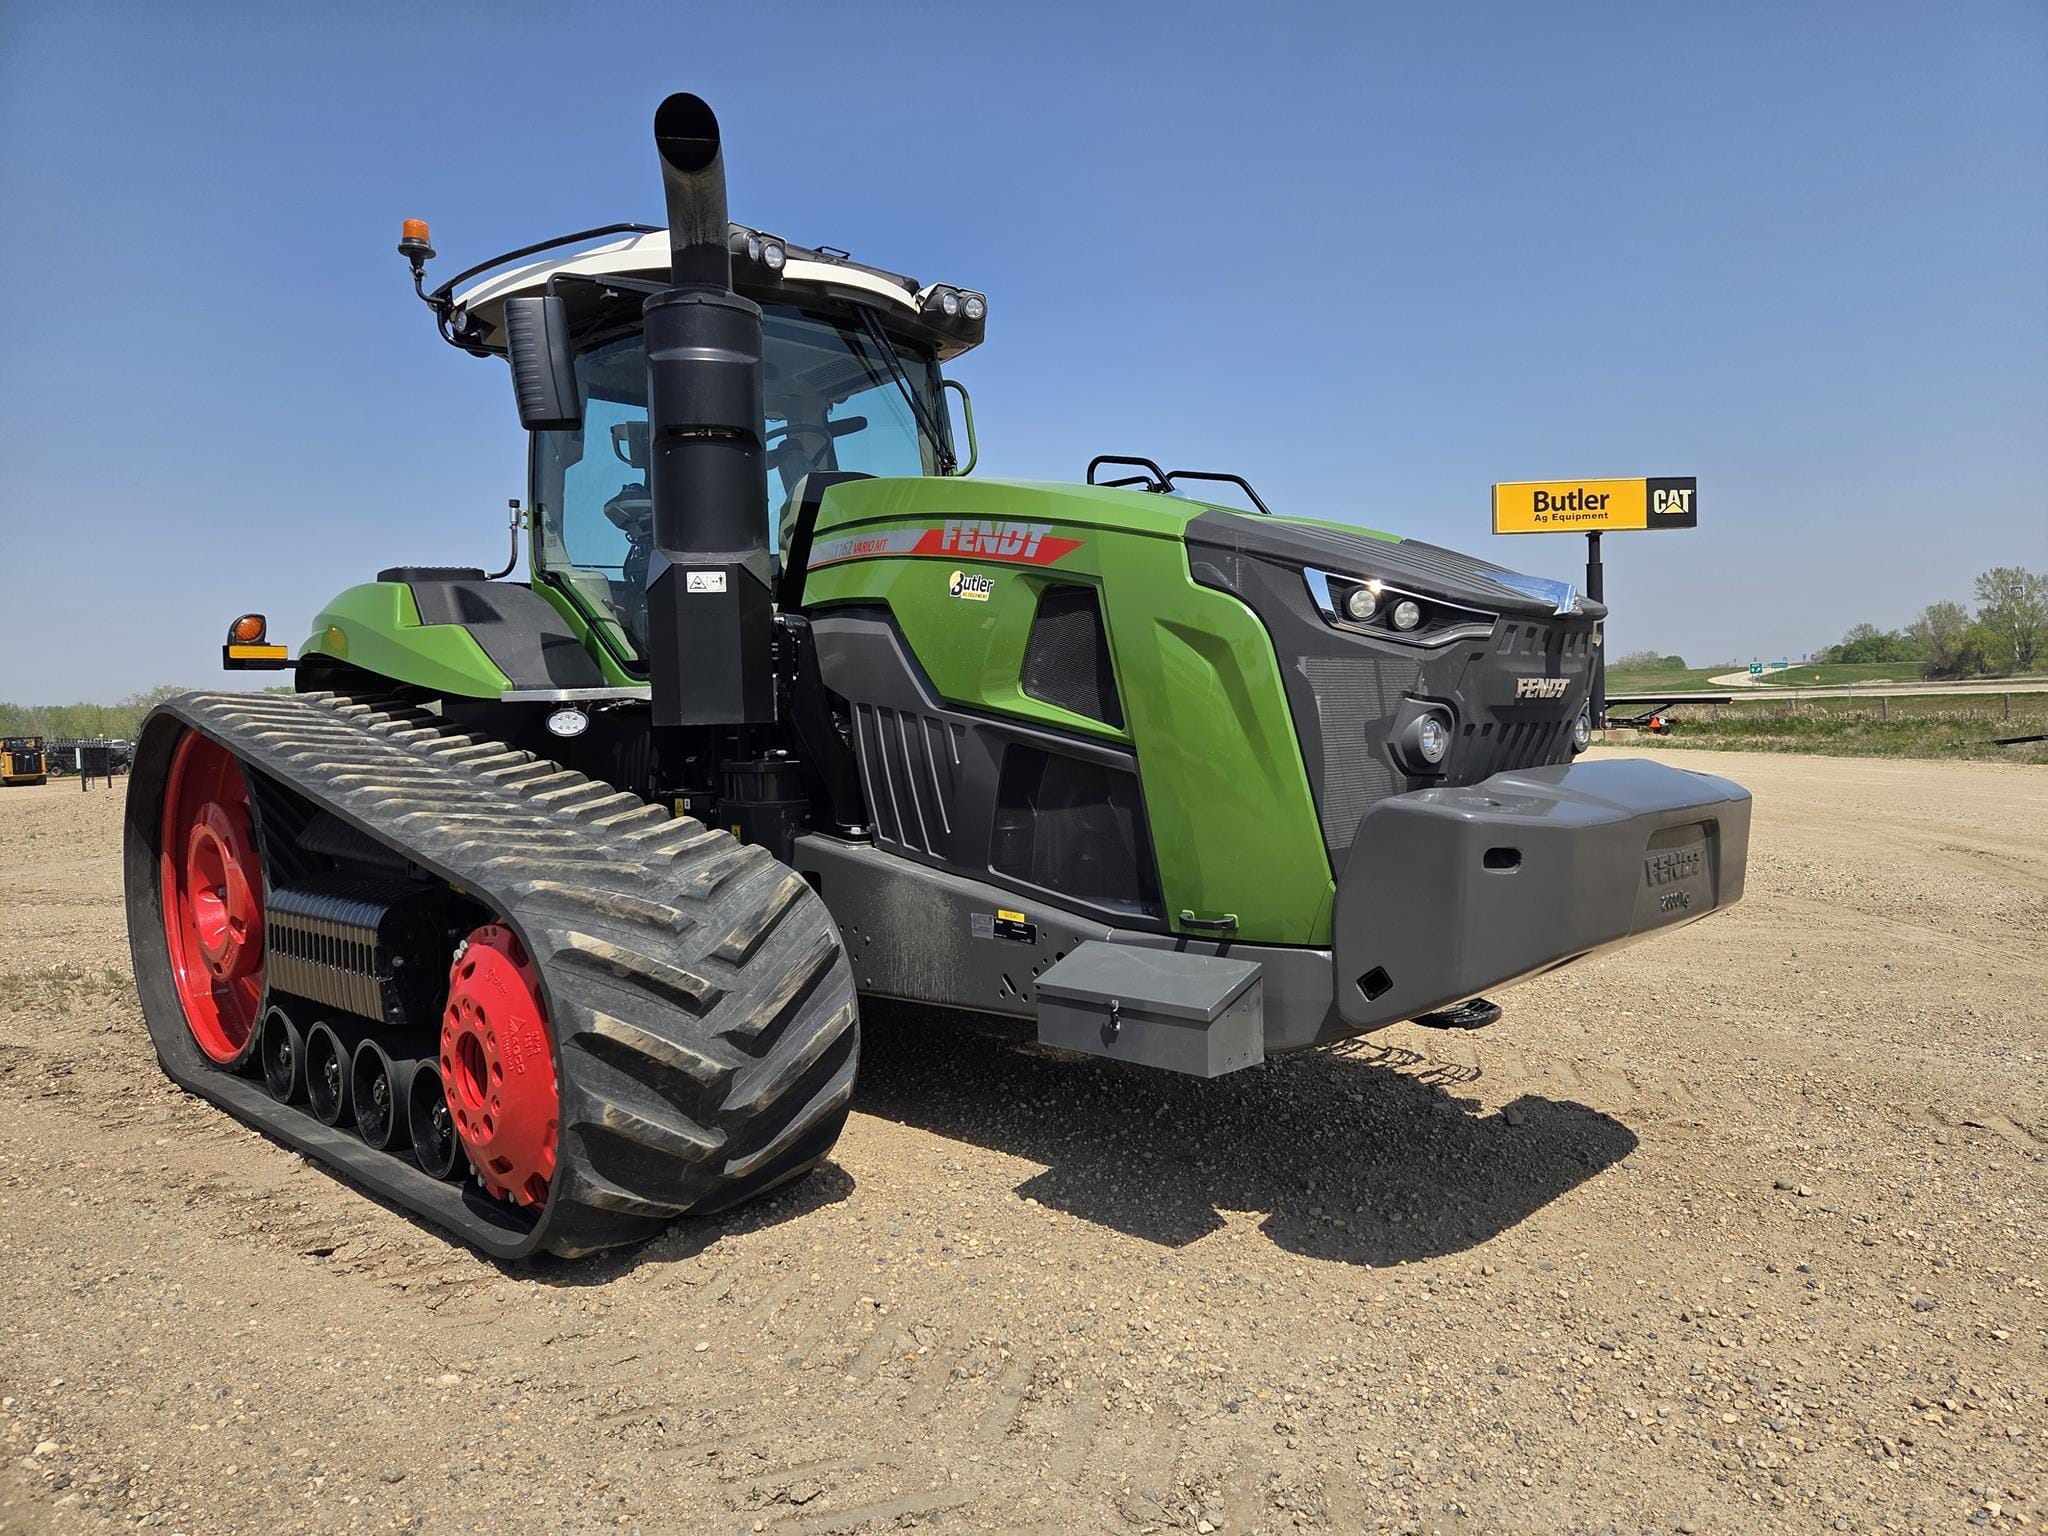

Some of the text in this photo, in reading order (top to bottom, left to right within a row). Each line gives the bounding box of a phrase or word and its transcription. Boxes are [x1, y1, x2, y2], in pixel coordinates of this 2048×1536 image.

[1533, 488, 1609, 512] Butler
[1653, 489, 1692, 514] CAT
[1534, 512, 1608, 523] Ag Equipment
[853, 540, 875, 554] VARIO
[875, 539, 888, 552] MT
[942, 519, 1053, 558] FENDT
[950, 572, 993, 596] Butler
[1515, 678, 1571, 698] FENDT
[1644, 848, 1703, 887] FENDT
